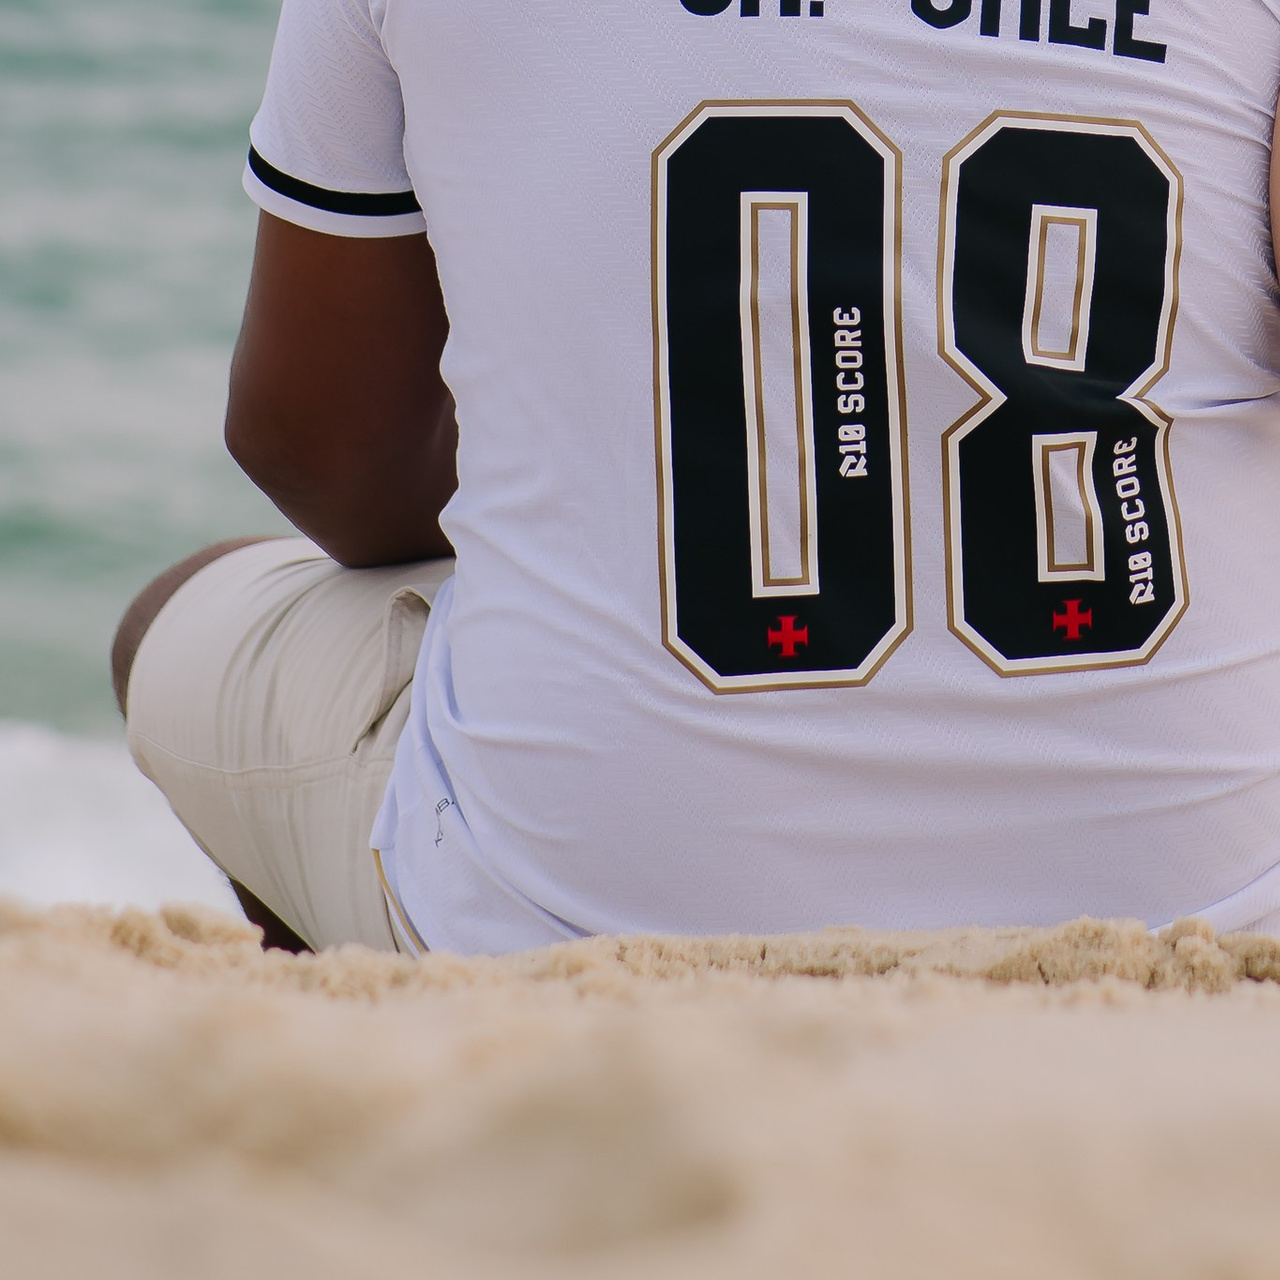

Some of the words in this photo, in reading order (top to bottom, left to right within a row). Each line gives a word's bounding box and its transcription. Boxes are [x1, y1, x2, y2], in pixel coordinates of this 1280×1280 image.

[651, 99, 1190, 695] 08
[832, 306, 865, 414] SCORE
[1112, 436, 1150, 544] SCORE
